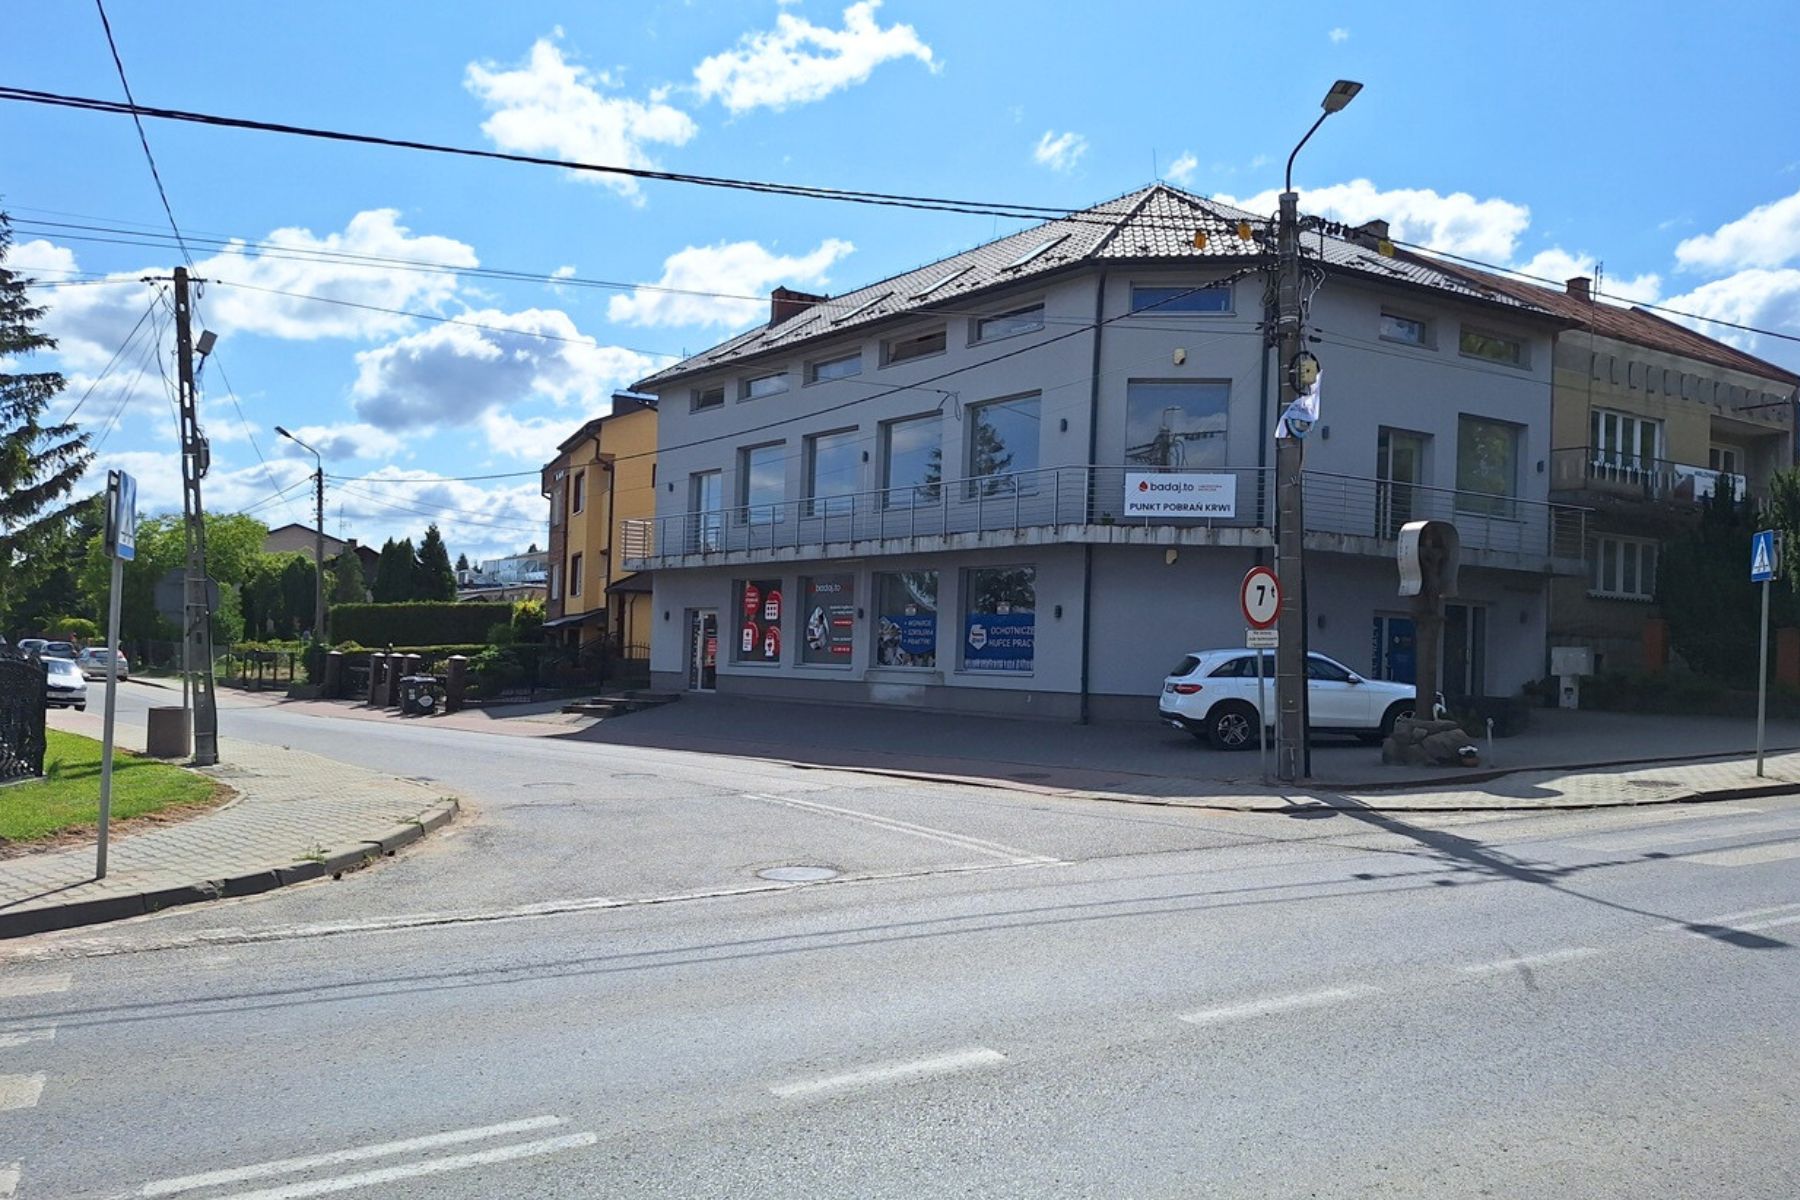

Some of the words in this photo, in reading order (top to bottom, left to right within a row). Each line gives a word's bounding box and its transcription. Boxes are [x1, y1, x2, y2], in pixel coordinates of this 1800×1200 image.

[1150, 482, 1194, 493] badaj.to
[1129, 502, 1160, 511] PUNKT
[1163, 501, 1203, 512] POBRAŃ
[1205, 503, 1231, 512] KRWI
[1256, 585, 1266, 607] 7
